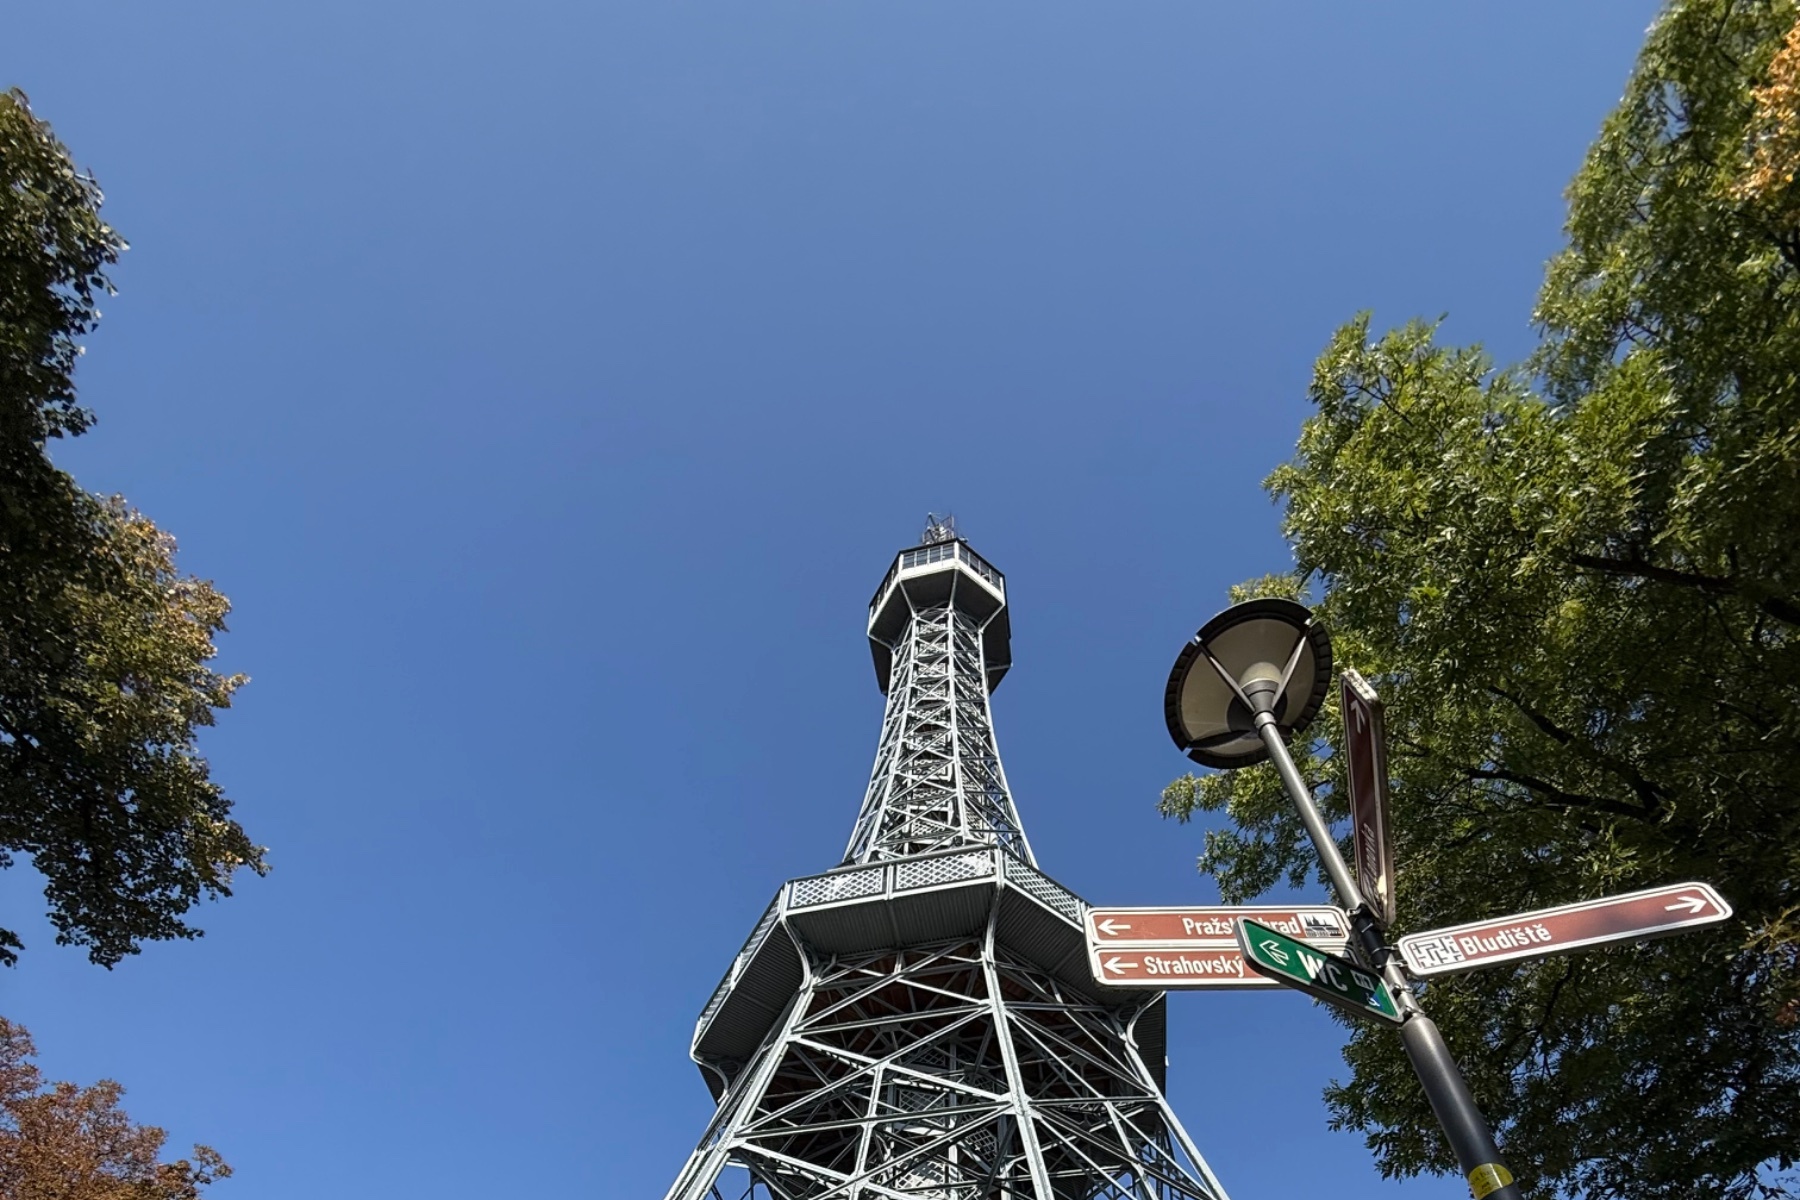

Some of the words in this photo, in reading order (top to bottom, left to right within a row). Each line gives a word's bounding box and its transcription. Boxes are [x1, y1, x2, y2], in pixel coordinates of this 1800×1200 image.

[1182, 917, 1237, 936] Pražs
[1458, 923, 1552, 956] Bludiště
[1143, 952, 1245, 978] Strahovský
[1296, 949, 1349, 992] WC
